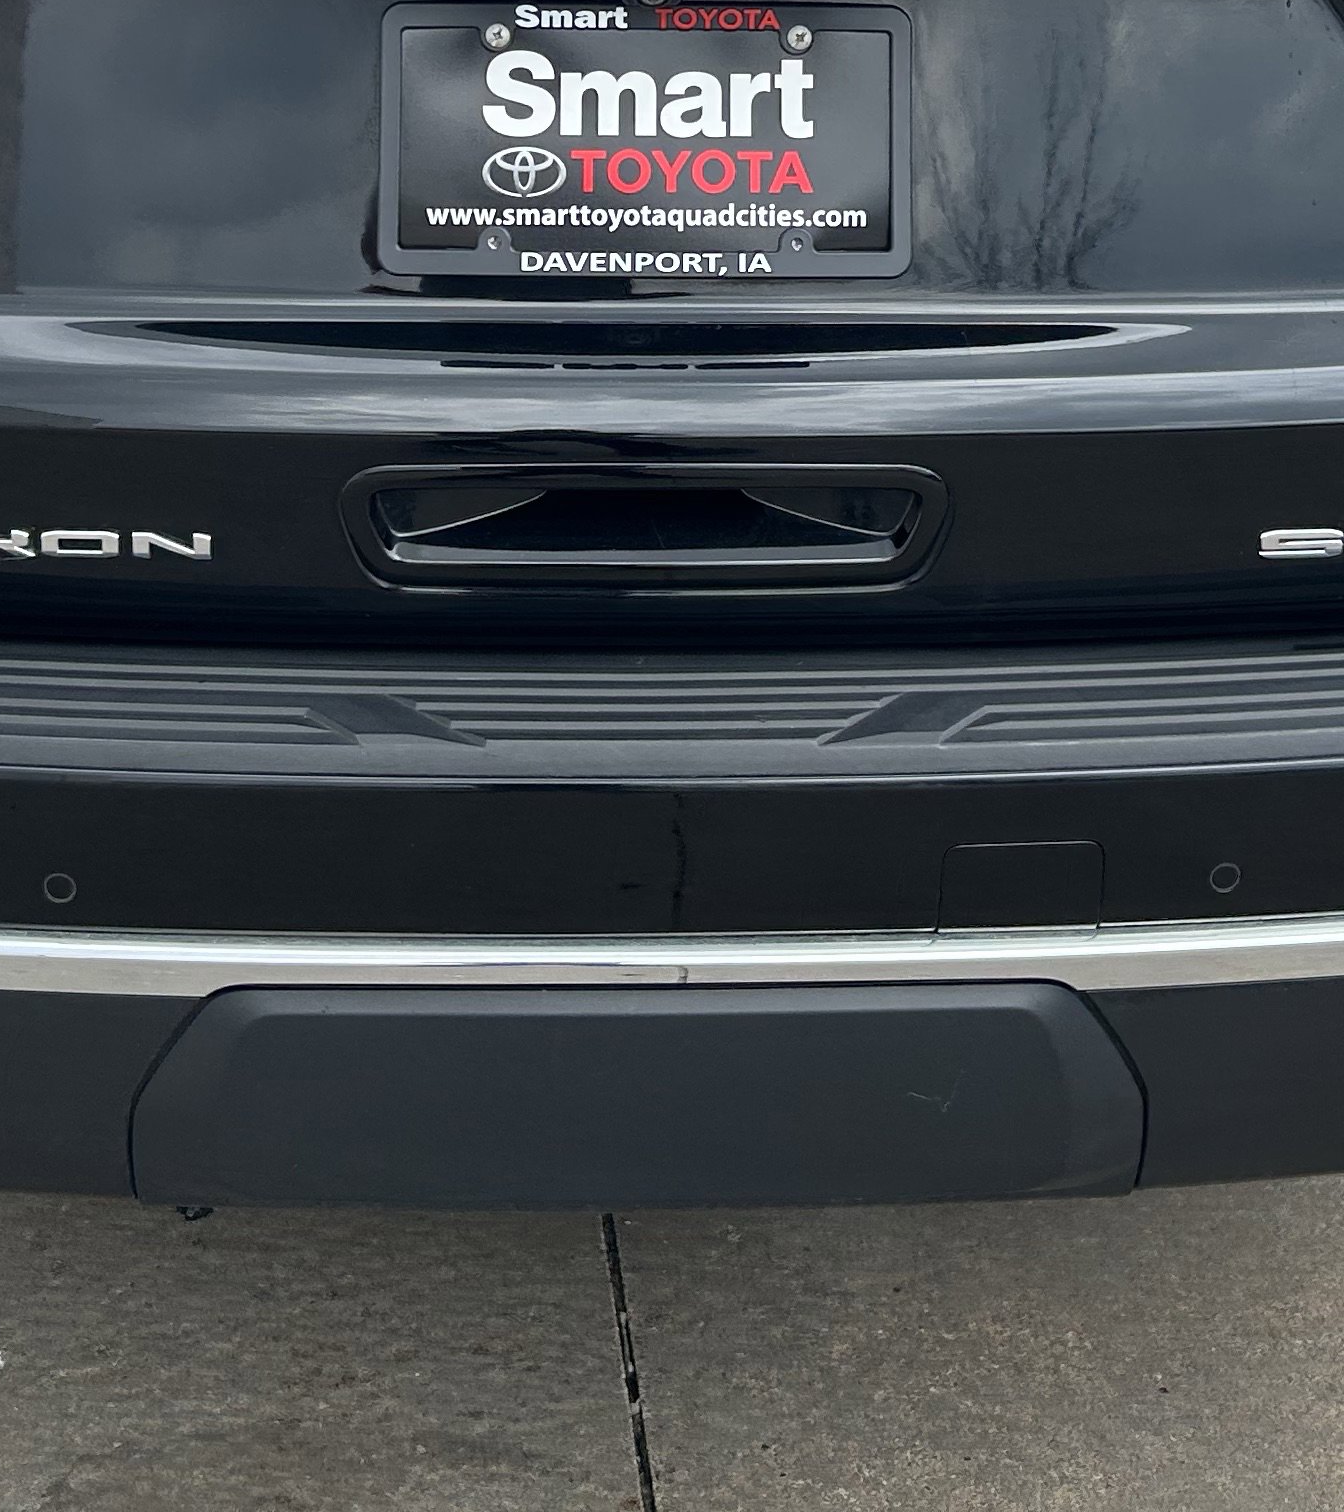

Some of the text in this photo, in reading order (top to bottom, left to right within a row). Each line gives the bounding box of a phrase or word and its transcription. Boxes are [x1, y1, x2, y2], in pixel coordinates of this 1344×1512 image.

[514, 4, 781, 31] Smart TOYOTA
[481, 50, 814, 138] Smart
[570, 149, 814, 194] TOYOTA
[426, 203, 868, 233] www.smarttoyotaquadcities.com
[520, 252, 772, 277] DAVENPORT, IA
